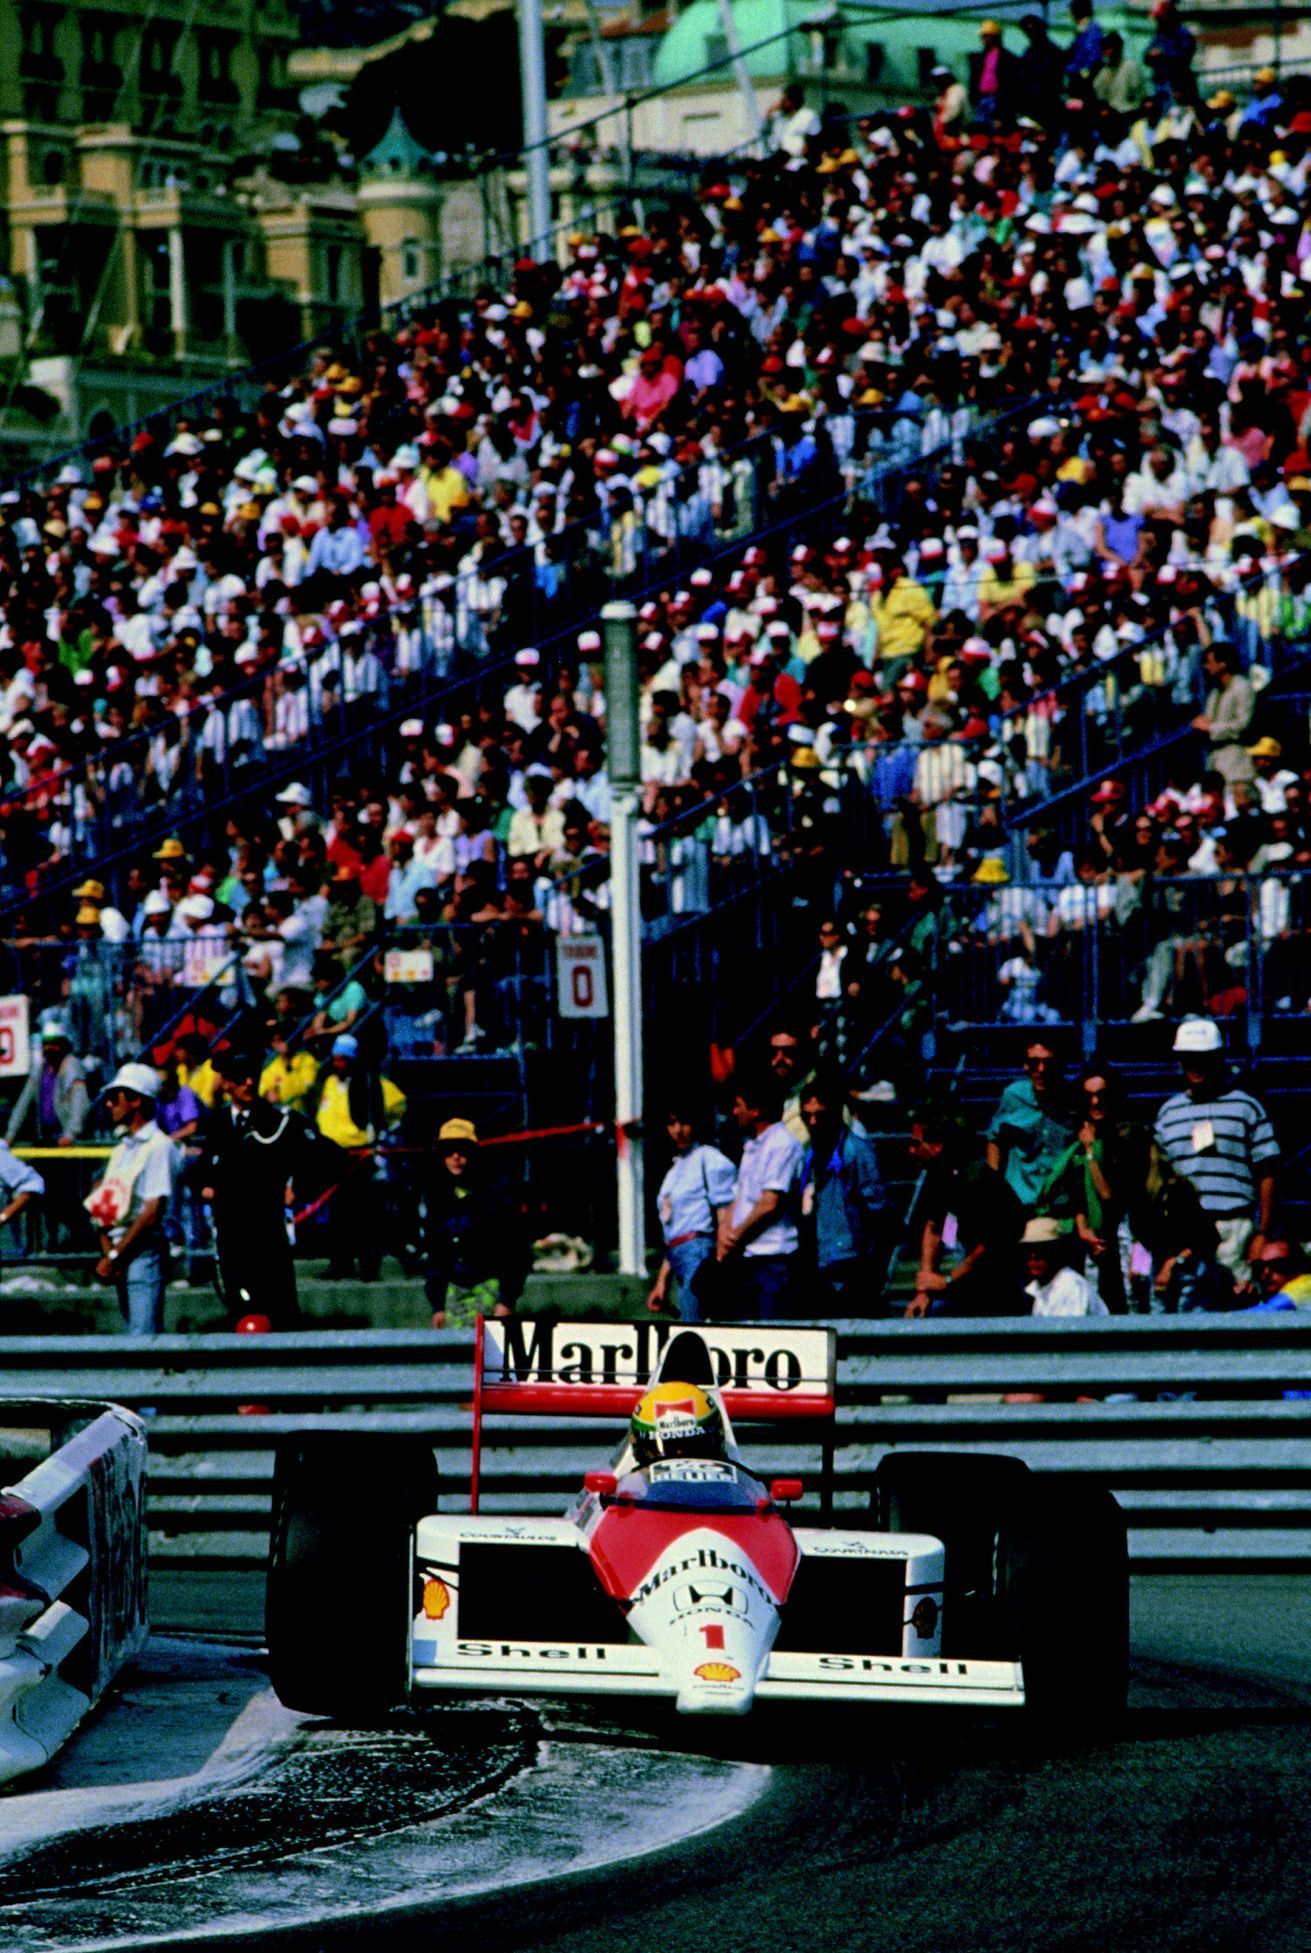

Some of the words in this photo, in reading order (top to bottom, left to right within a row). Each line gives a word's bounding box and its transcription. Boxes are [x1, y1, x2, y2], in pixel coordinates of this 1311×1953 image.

[648, 1426, 706, 1440] HONDA
[631, 1549, 773, 1605] Marlboro
[669, 1607, 756, 1632] HONDA
[699, 1624, 725, 1650] 1
[457, 1643, 606, 1659] Shell
[818, 1657, 968, 1675] Shell
